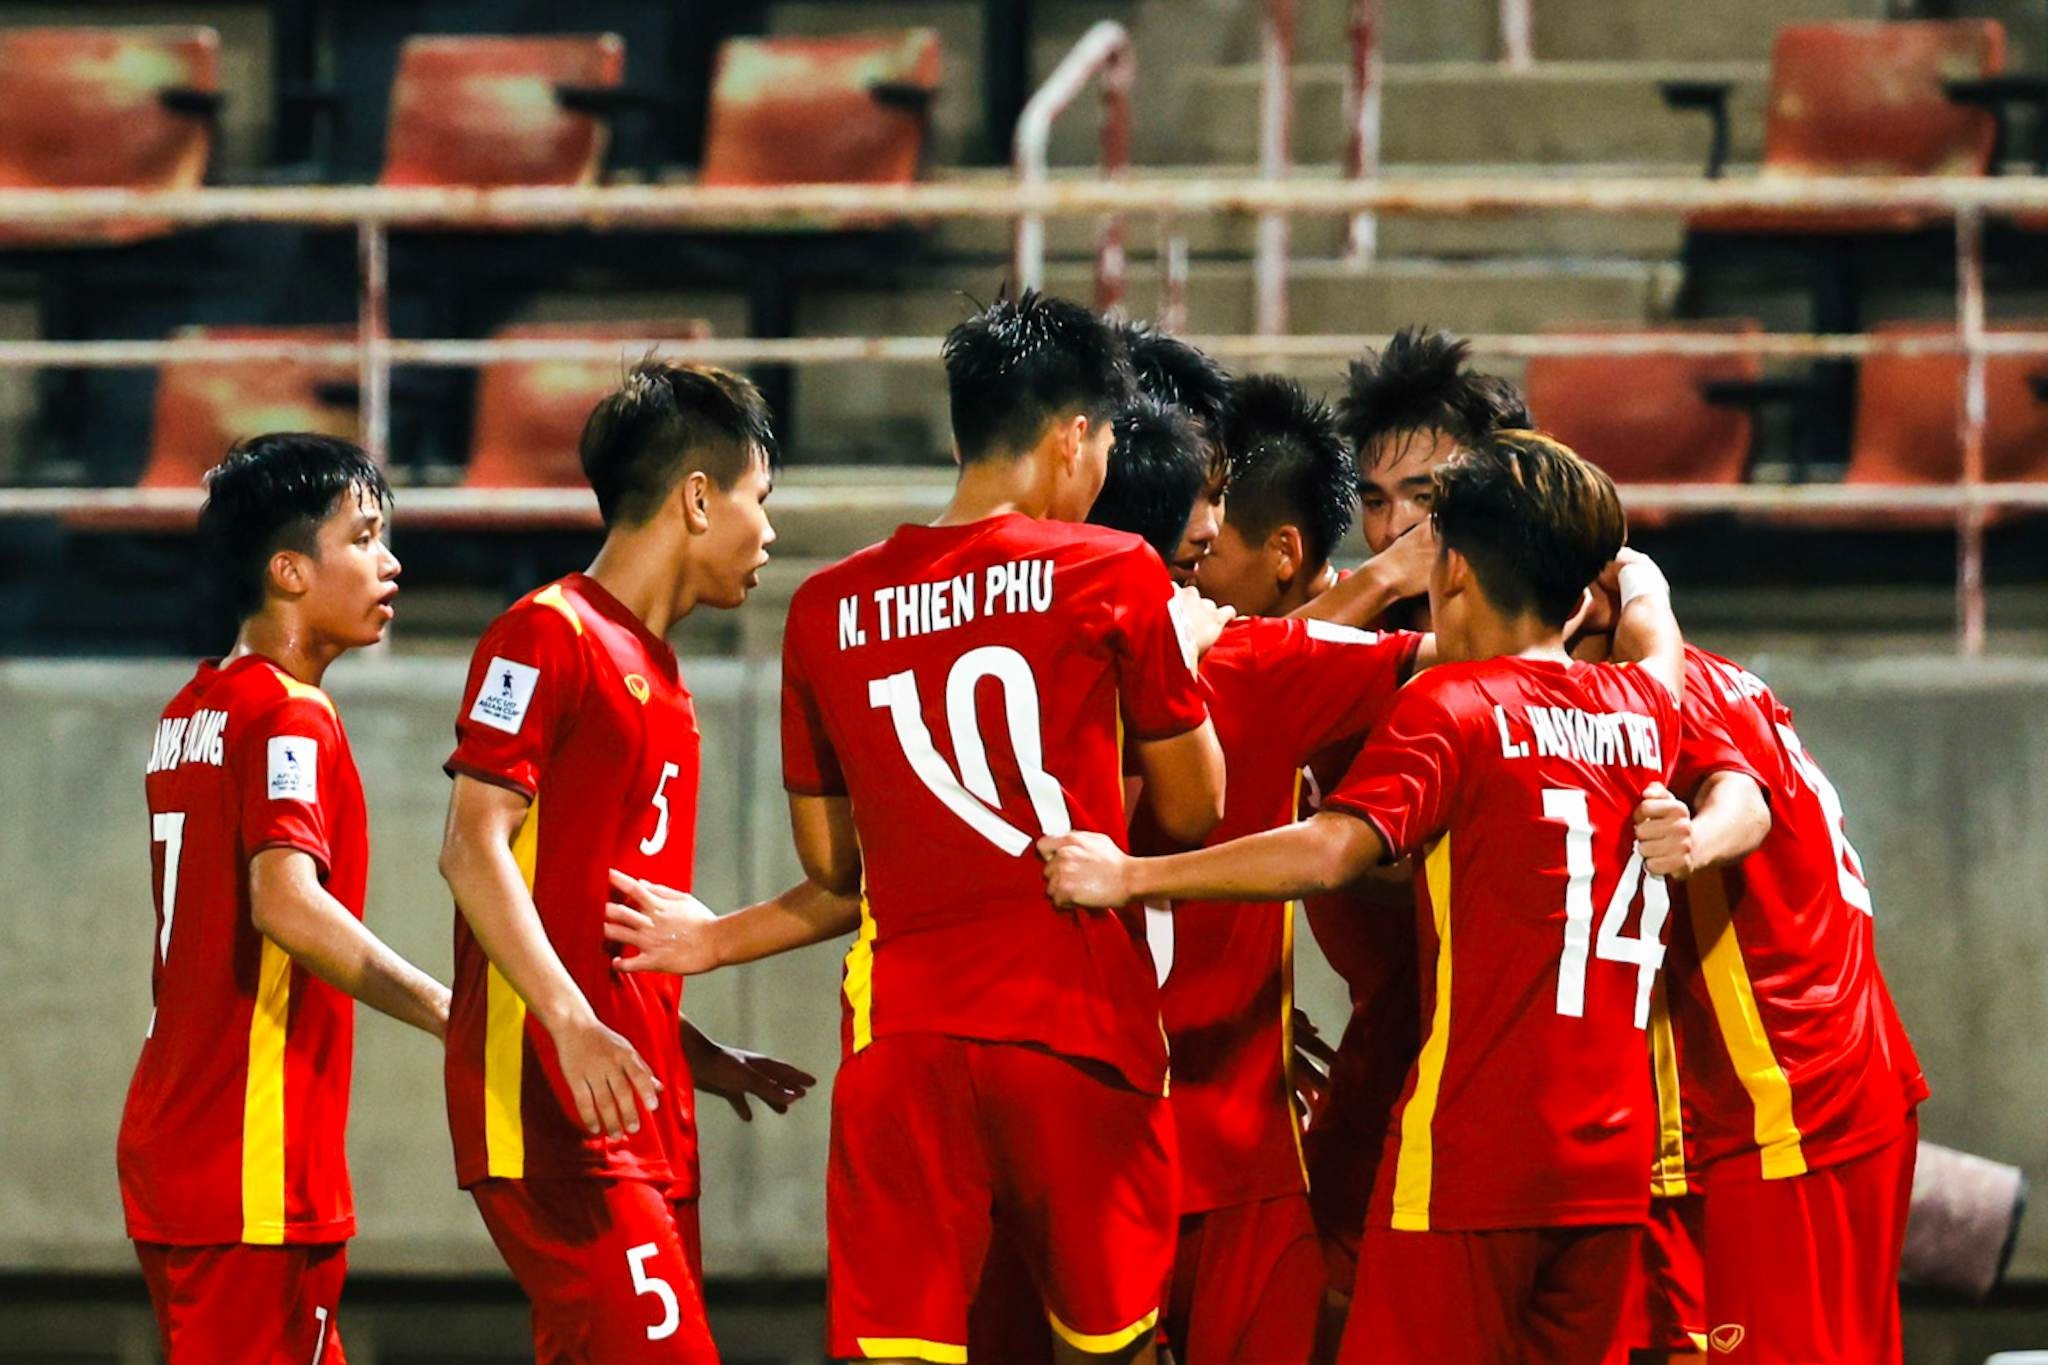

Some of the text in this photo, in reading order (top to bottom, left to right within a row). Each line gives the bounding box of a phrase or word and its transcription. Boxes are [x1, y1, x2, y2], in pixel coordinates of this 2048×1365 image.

[839, 560, 1055, 651] N. THIEN PHU
[868, 646, 1071, 857] 10
[1494, 705, 1530, 758] L.
[639, 760, 680, 856] 5
[1541, 788, 1670, 1031] 14
[625, 1241, 681, 1341] 5
